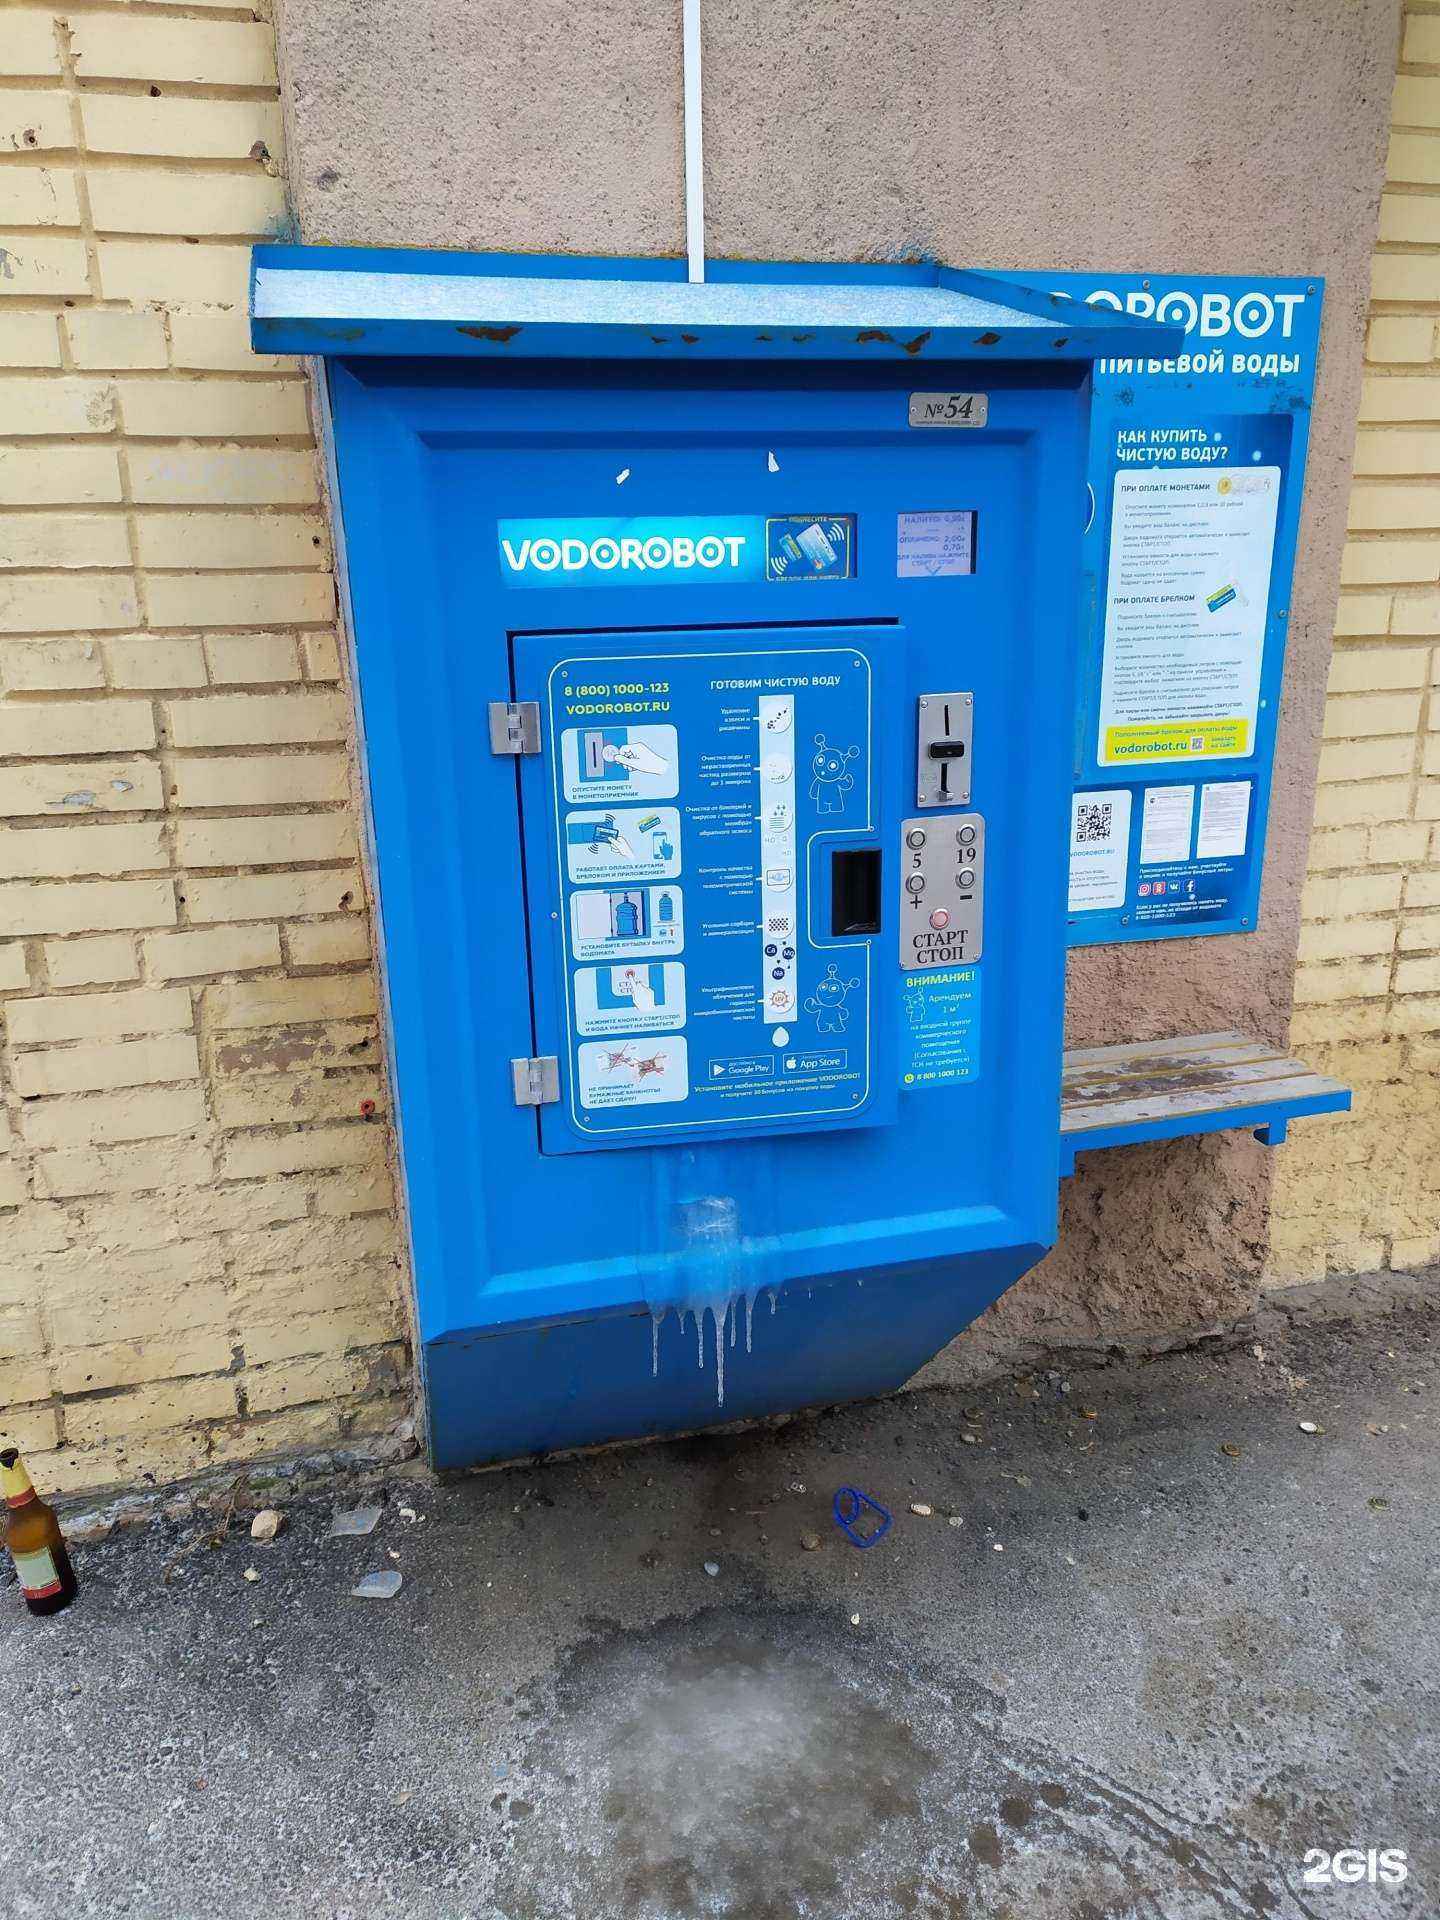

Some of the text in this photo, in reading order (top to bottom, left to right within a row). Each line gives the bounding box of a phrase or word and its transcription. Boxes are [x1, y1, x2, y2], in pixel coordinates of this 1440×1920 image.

[1232, 354, 1300, 377] ВОДЫ
[1117, 429, 1208, 444] КАК КУПИТЬ
[1116, 446, 1229, 462] ЧИСТУЮ ВОДУ?
[1121, 485, 1138, 493] ПРИ
[1170, 483, 1211, 492] МОНЕТАМИ
[501, 535, 747, 573] VODOROBOT
[1113, 597, 1130, 605] ПРИ
[1131, 596, 1159, 605] ОПЛАТЕ
[564, 682, 670, 698] 8 (800) 1000-123
[710, 675, 842, 690] ГОТОВИМ ЧИСТУЮ ВОДУ
[566, 701, 671, 715] VODOROBOT.RU
[1114, 741, 1188, 754] vodorobot.ru
[572, 785, 606, 793] ОПУСТИТЕ
[912, 847, 976, 868] 5 19
[912, 929, 968, 948] СТАРТ
[916, 946, 963, 964] СТОП
[906, 970, 975, 987] ВНИМАНИЕ!
[928, 992, 972, 1003] Арендуем
[728, 1064, 770, 1075] Google Play
[800, 1059, 817, 1069] App
[818, 1057, 841, 1067] Store
